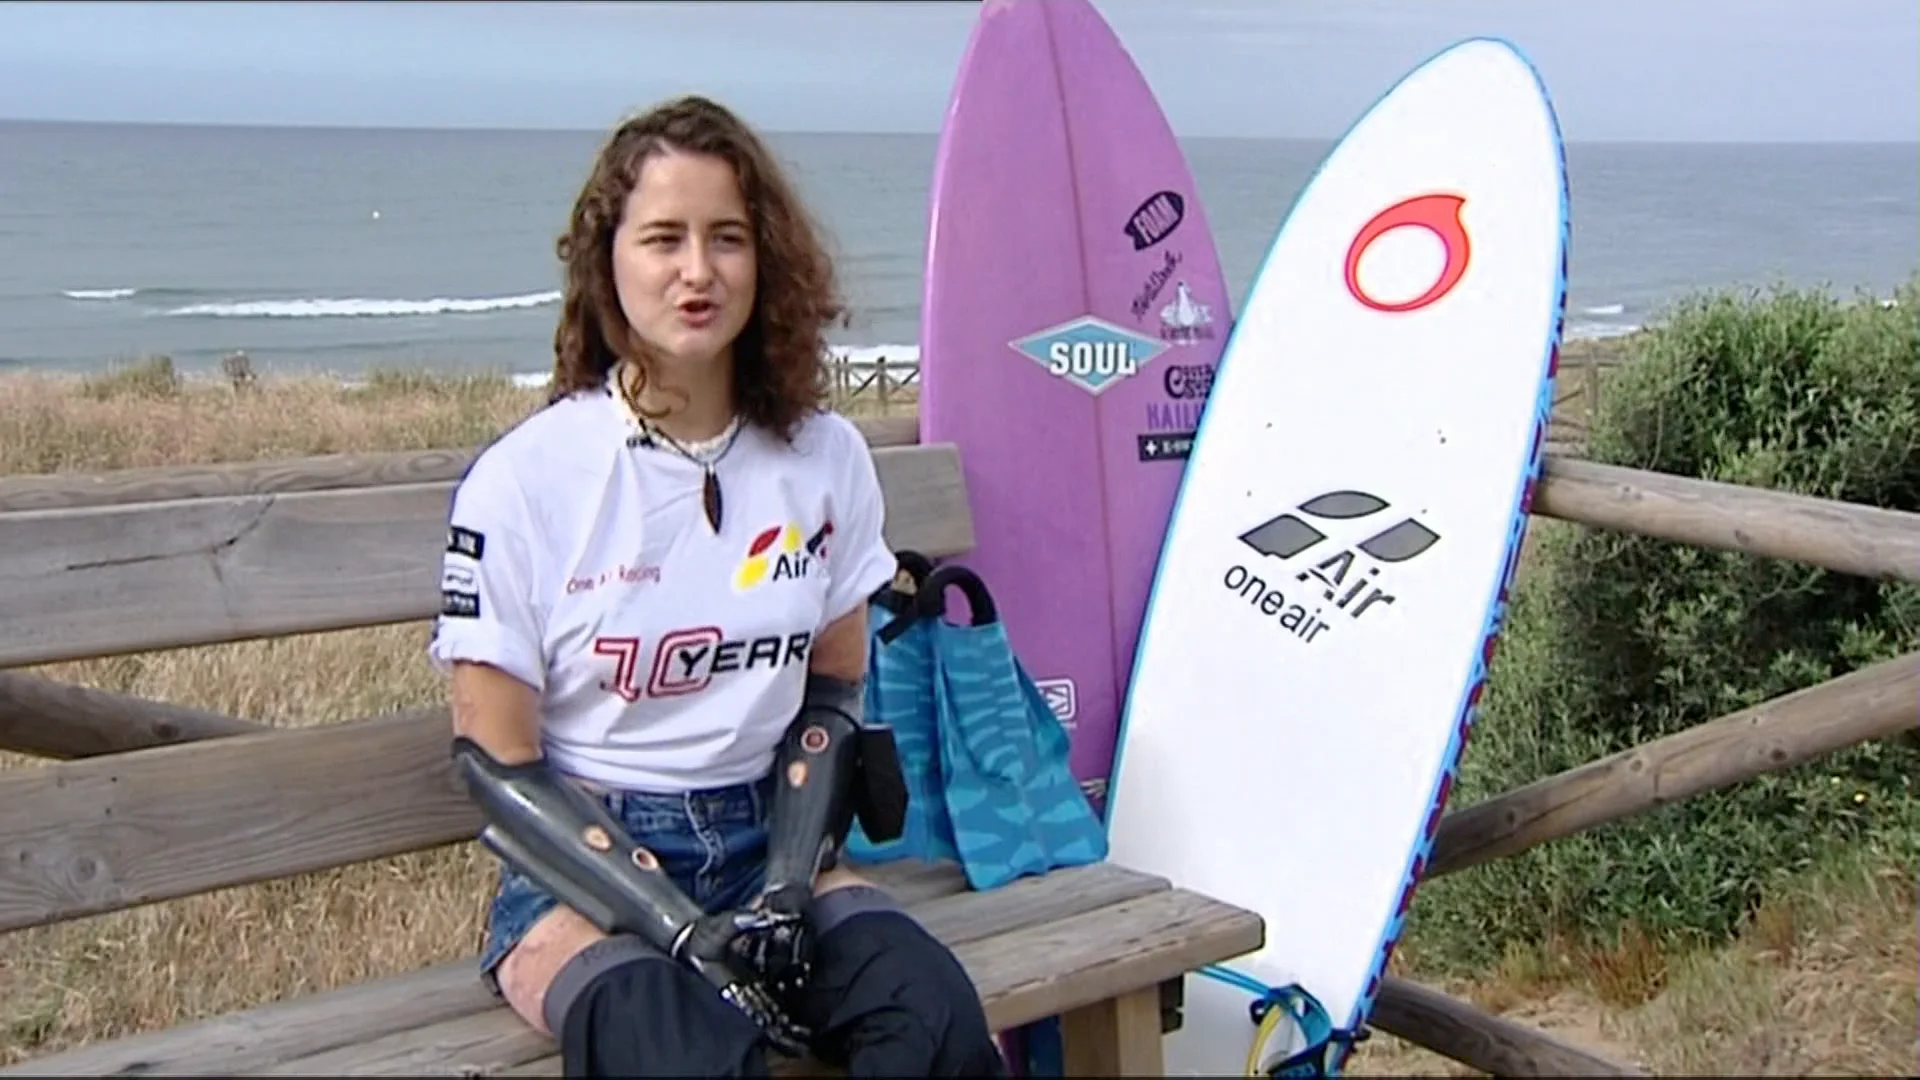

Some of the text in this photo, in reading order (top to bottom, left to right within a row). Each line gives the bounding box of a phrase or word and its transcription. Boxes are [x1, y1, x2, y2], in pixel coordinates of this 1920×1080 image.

[1132, 195, 1180, 245] FOAM
[1050, 342, 1137, 375] SOUL
[772, 551, 809, 581] Air
[1295, 550, 1396, 619] Air
[1223, 564, 1331, 644] oneair
[594, 626, 723, 702] 10
